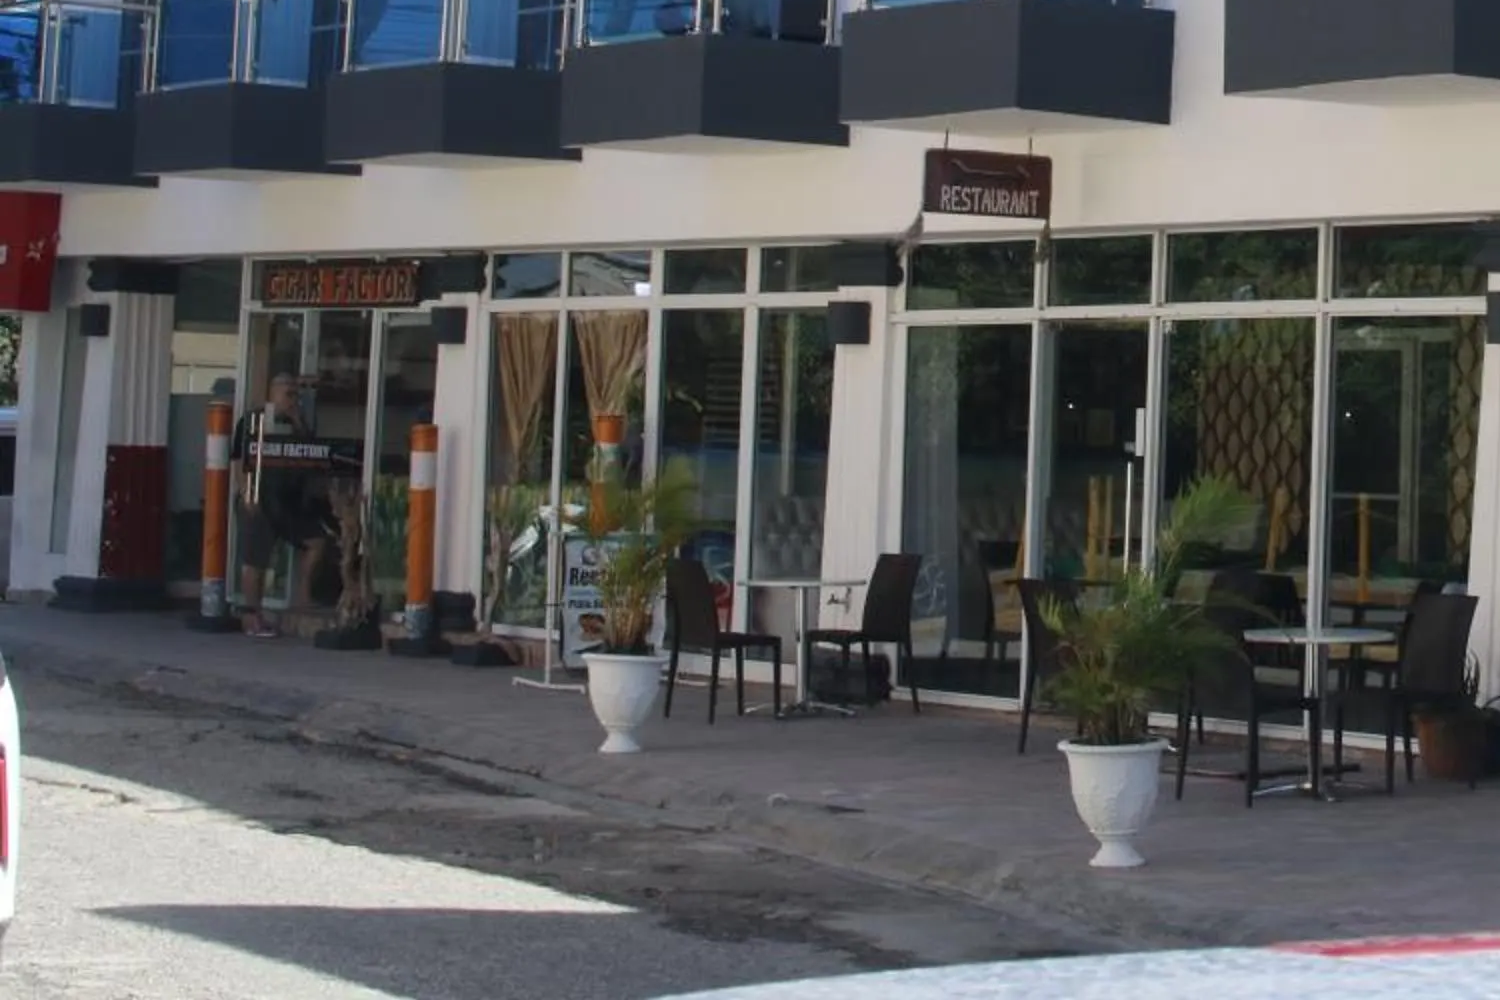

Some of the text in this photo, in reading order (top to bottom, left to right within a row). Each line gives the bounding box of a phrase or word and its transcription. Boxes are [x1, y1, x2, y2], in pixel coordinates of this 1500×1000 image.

[941, 183, 1040, 217] RESTAURANT
[269, 264, 417, 304] CIGAR FACTORY
[249, 441, 331, 460] CGAR FACTORY
